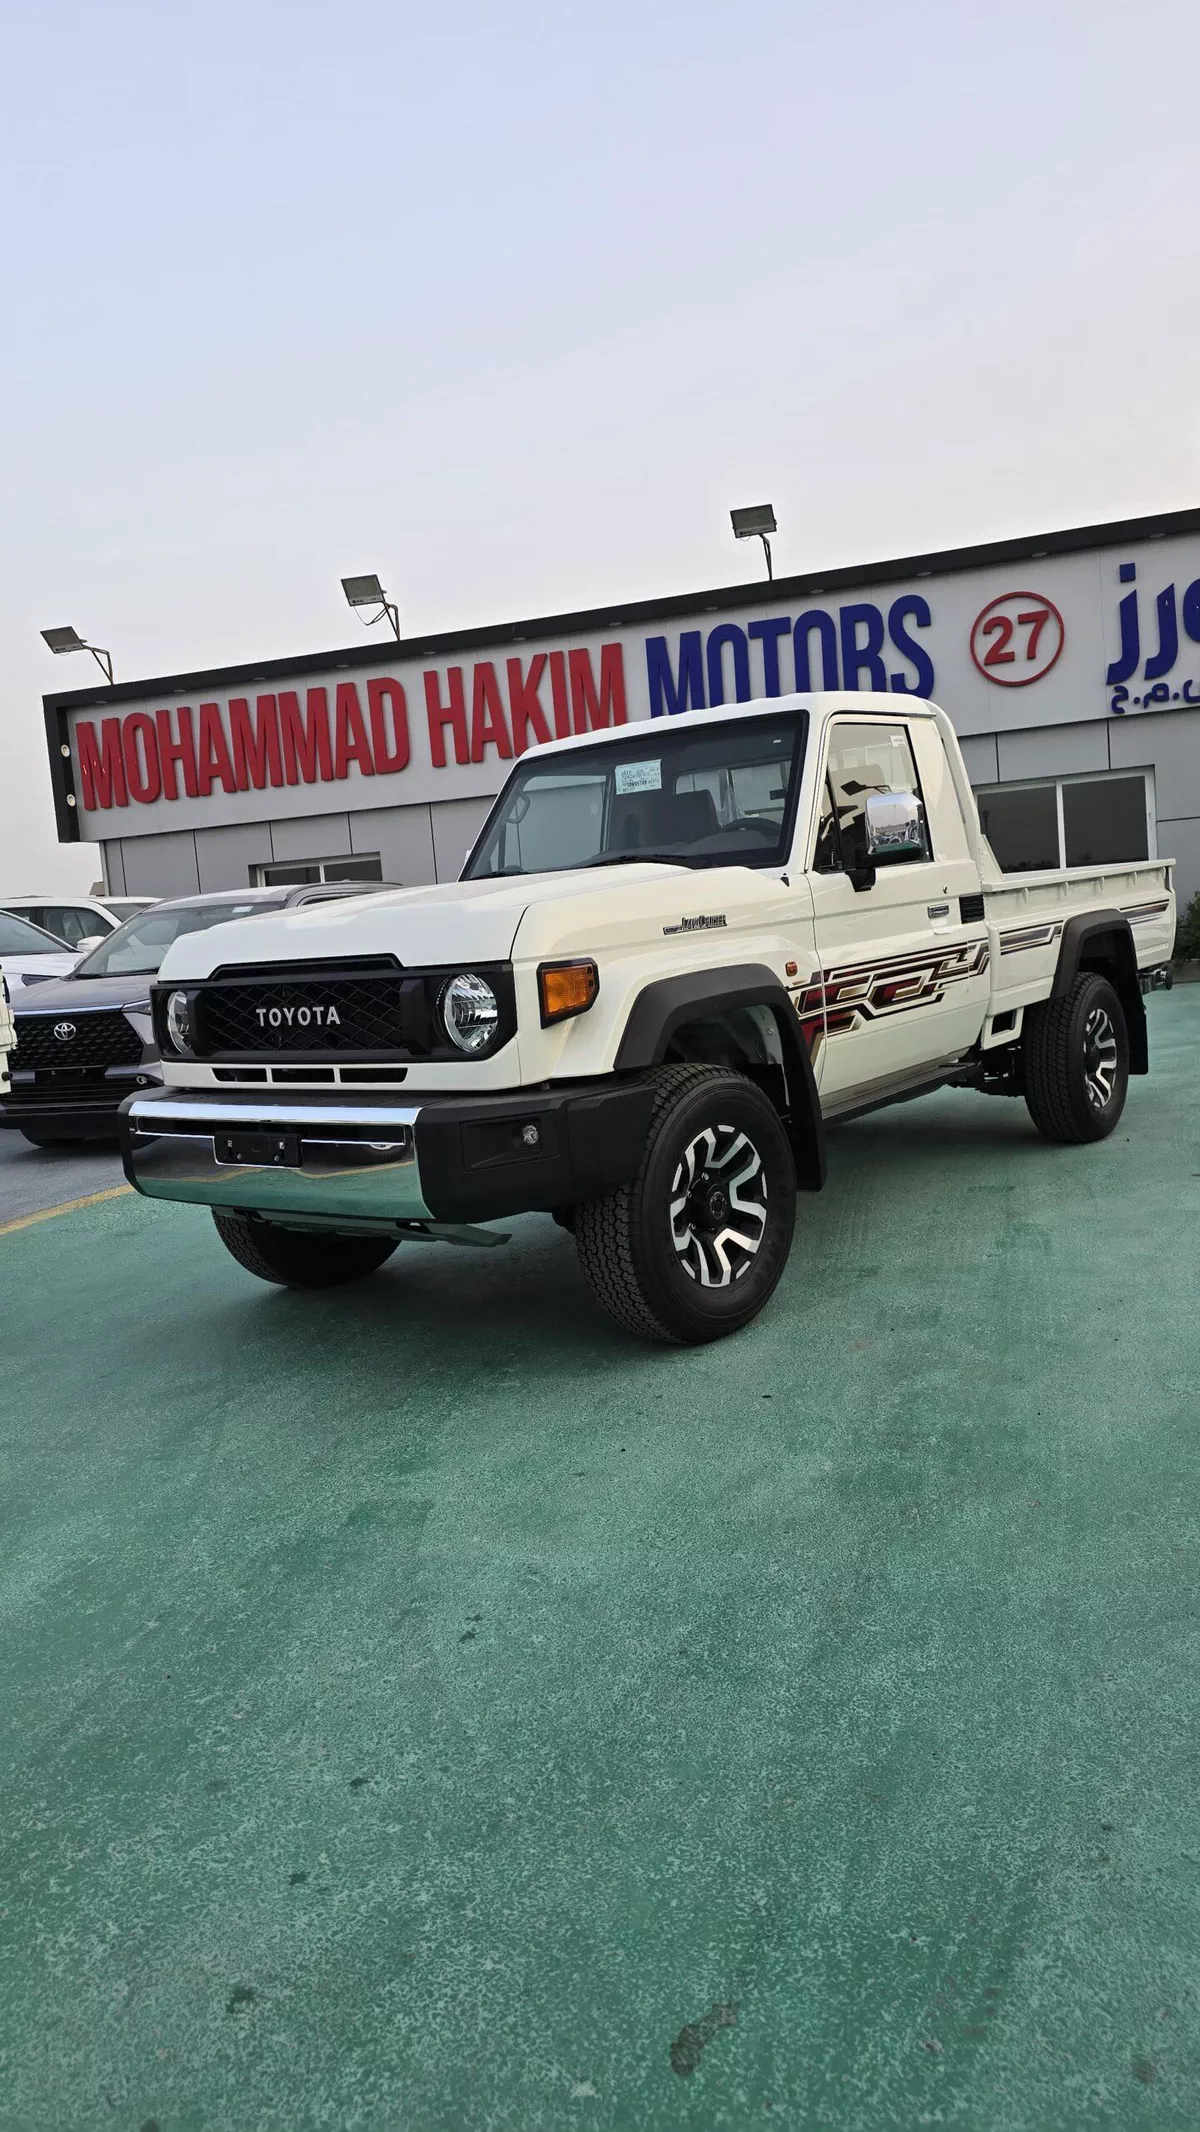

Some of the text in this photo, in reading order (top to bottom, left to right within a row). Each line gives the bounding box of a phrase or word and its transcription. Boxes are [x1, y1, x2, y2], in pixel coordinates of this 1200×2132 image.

[982, 609, 1051, 667] 27
[76, 594, 936, 812] MOHAMMAD HAKIM MOTORS
[255, 1006, 341, 1027] TOYOTA
